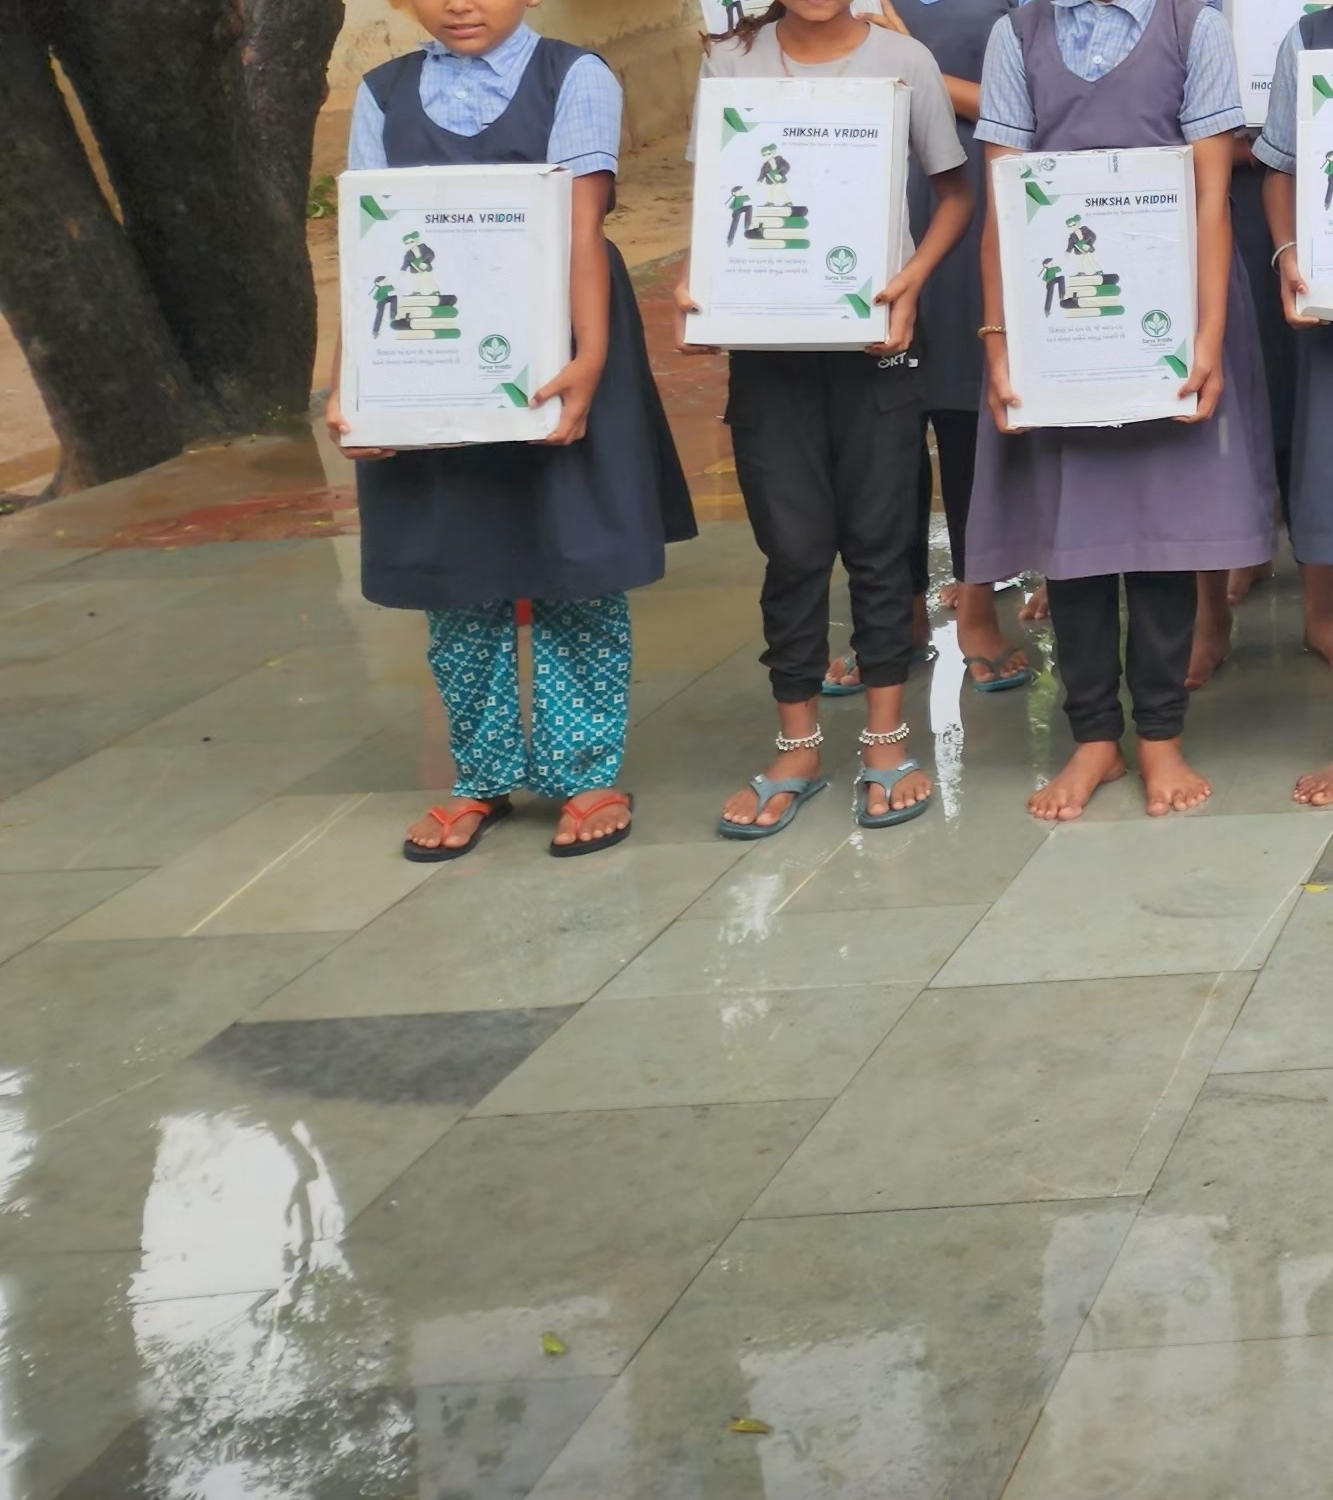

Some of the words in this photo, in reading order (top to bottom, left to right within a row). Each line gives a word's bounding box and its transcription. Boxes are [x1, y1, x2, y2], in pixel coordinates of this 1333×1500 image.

[783, 127, 829, 138] SHIKSHA
[834, 128, 878, 139] VRIDDHI
[1085, 196, 1131, 207] SHIKSHA
[1135, 194, 1177, 205] VRIDDHI
[424, 213, 474, 224] SHIKSHA
[479, 212, 525, 224] VRIDDHI
